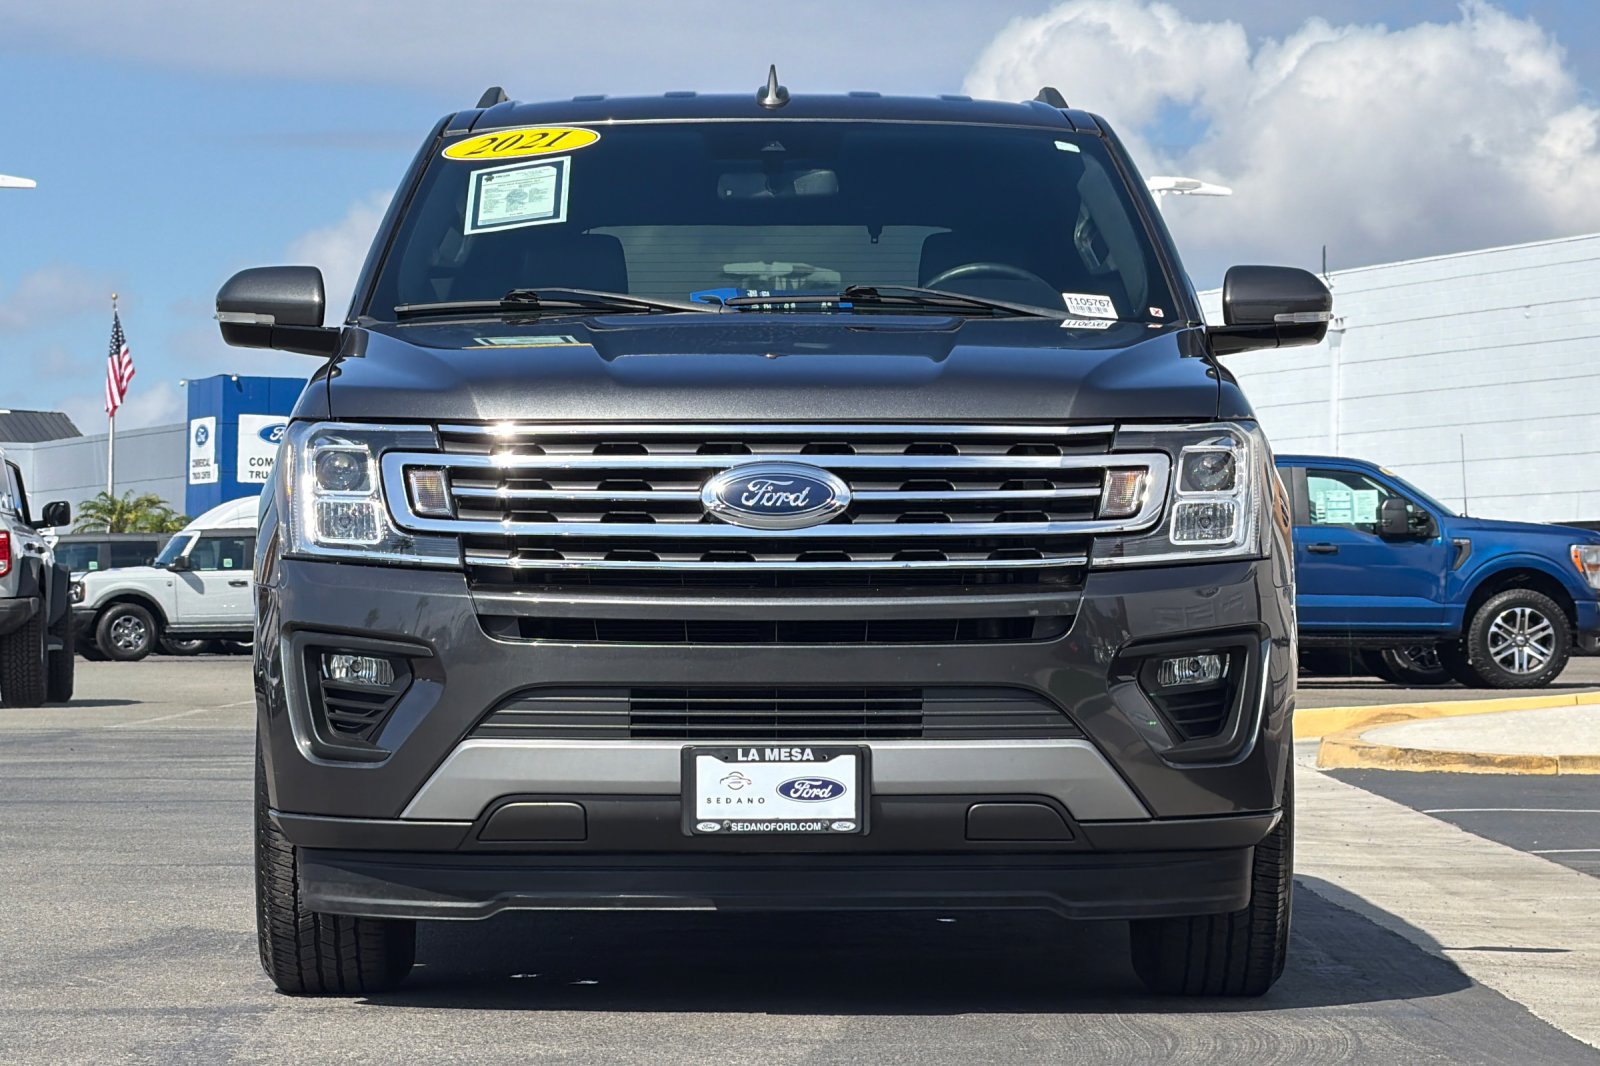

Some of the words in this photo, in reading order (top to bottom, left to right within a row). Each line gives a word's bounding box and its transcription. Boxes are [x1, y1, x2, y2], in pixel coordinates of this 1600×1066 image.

[463, 130, 573, 157] 2021
[1066, 297, 1110, 307] T105767
[741, 479, 811, 507] Ford
[737, 748, 760, 761] LA
[764, 748, 815, 761] MESA
[789, 779, 833, 799] Ford
[731, 822, 822, 831] SEDANOFORD.COM
